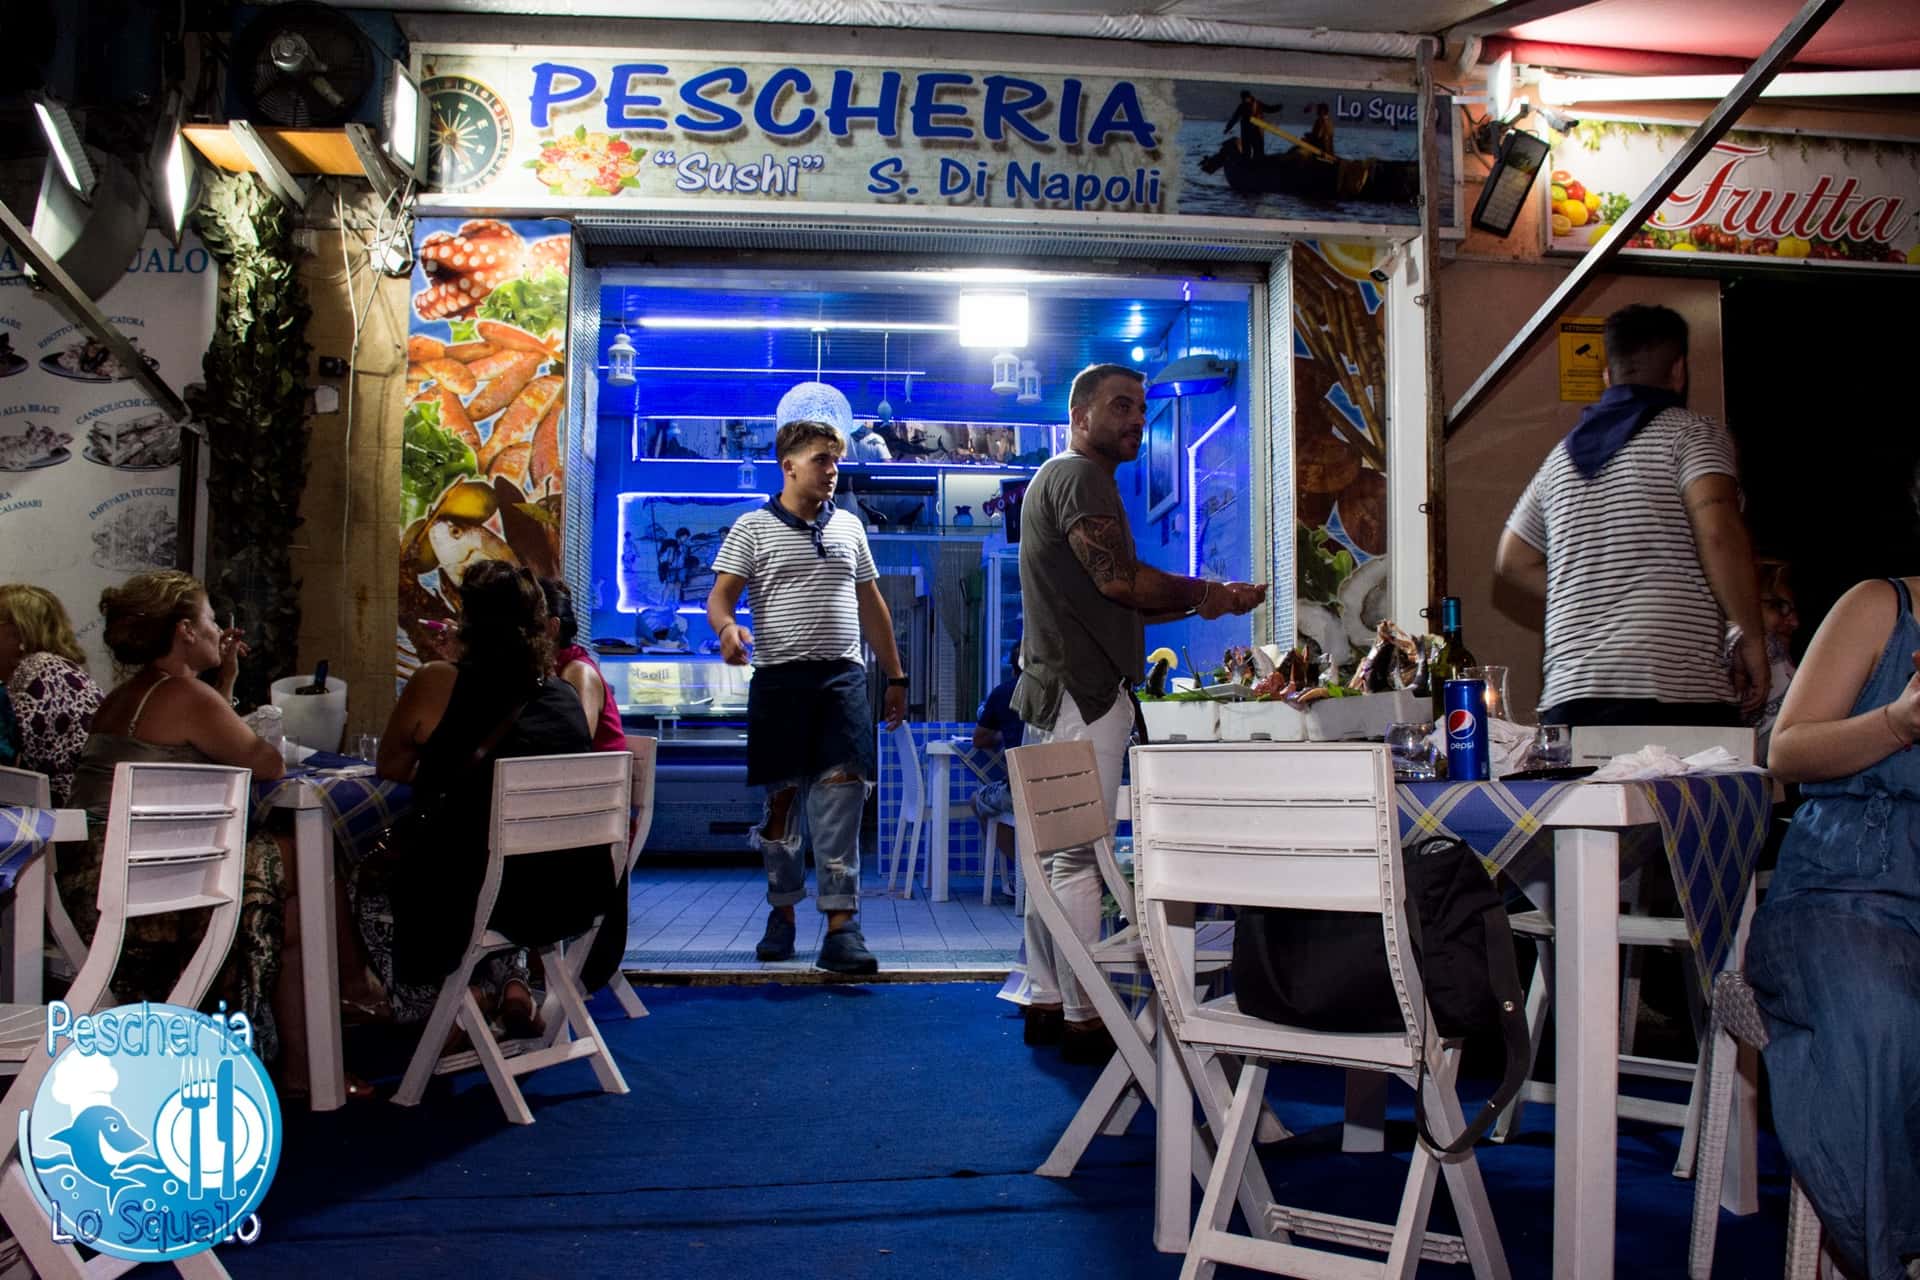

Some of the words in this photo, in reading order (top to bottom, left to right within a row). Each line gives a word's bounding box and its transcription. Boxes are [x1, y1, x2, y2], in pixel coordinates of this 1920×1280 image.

[528, 62, 1157, 148] PESCHERIA
[1336, 95, 1362, 118] Lo
[1368, 97, 1440, 127] Squa
[868, 157, 919, 195] S.
[939, 158, 988, 197] Di
[1006, 161, 1161, 211] Napoli
[1648, 141, 1905, 244] Frutta
[126, 247, 209, 274] UALO
[1450, 741, 1475, 751] pepsi
